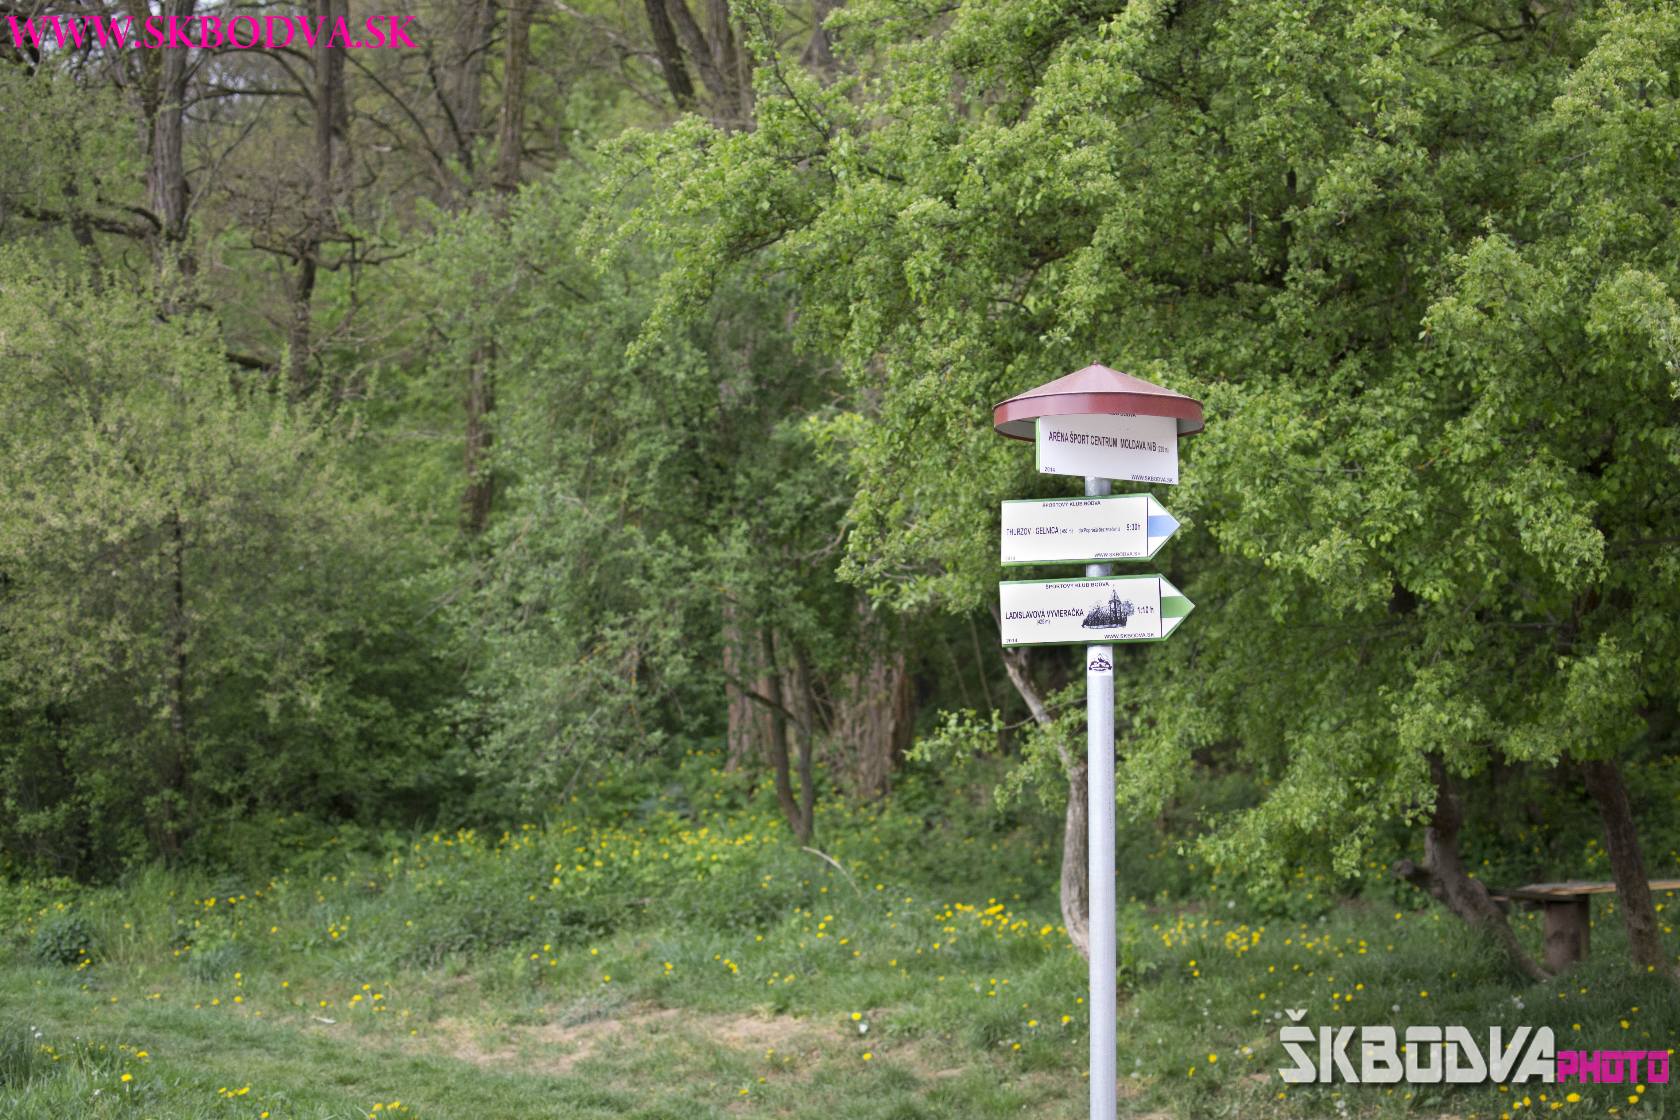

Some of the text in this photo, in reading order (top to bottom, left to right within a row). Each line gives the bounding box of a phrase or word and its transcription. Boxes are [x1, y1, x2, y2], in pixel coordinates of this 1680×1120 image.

[1070, 431, 1089, 444] ŠPORT
[1090, 435, 1118, 448] CENTRUM
[1120, 438, 1146, 450] MOLDAVA
[1036, 526, 1058, 535] GELNICA
[1046, 608, 1084, 618] VYVIERAČKA
